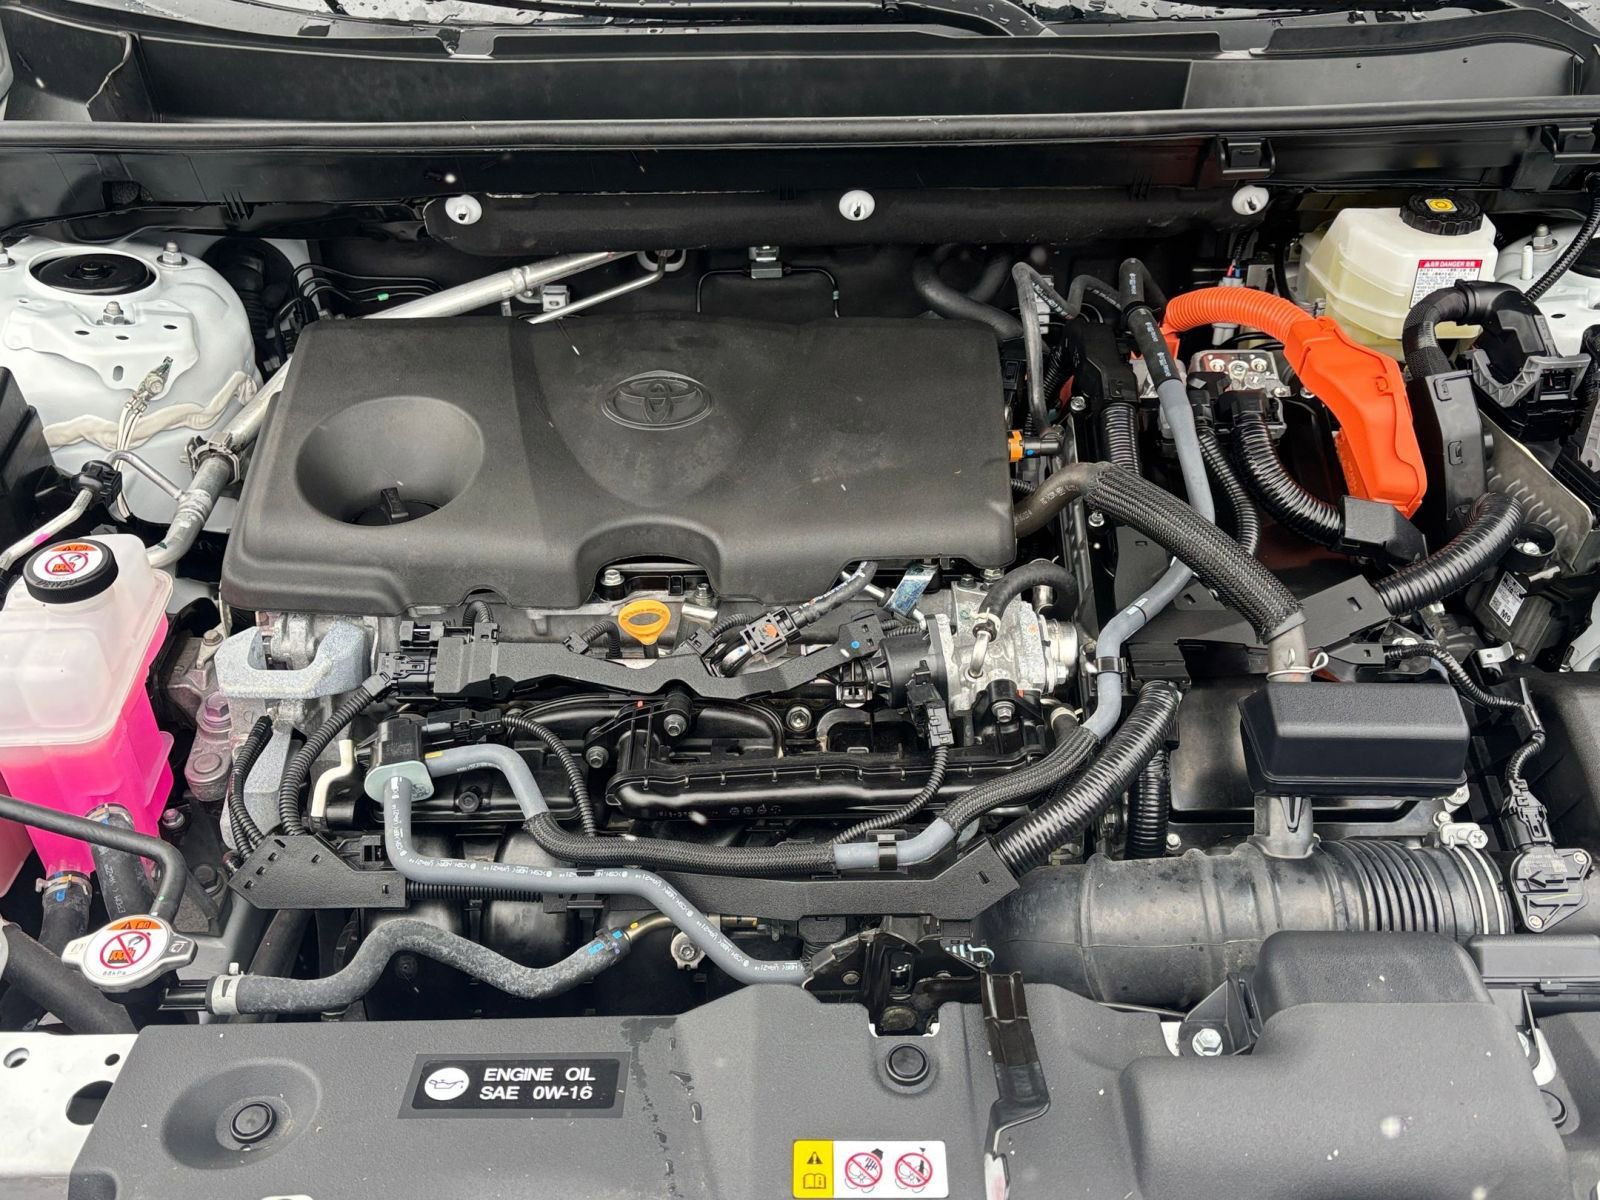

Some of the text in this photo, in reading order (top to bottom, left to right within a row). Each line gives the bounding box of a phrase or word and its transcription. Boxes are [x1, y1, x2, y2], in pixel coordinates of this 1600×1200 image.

[483, 1067, 596, 1082] ENGINE OIL
[479, 1085, 593, 1100] SAE 0W-16
